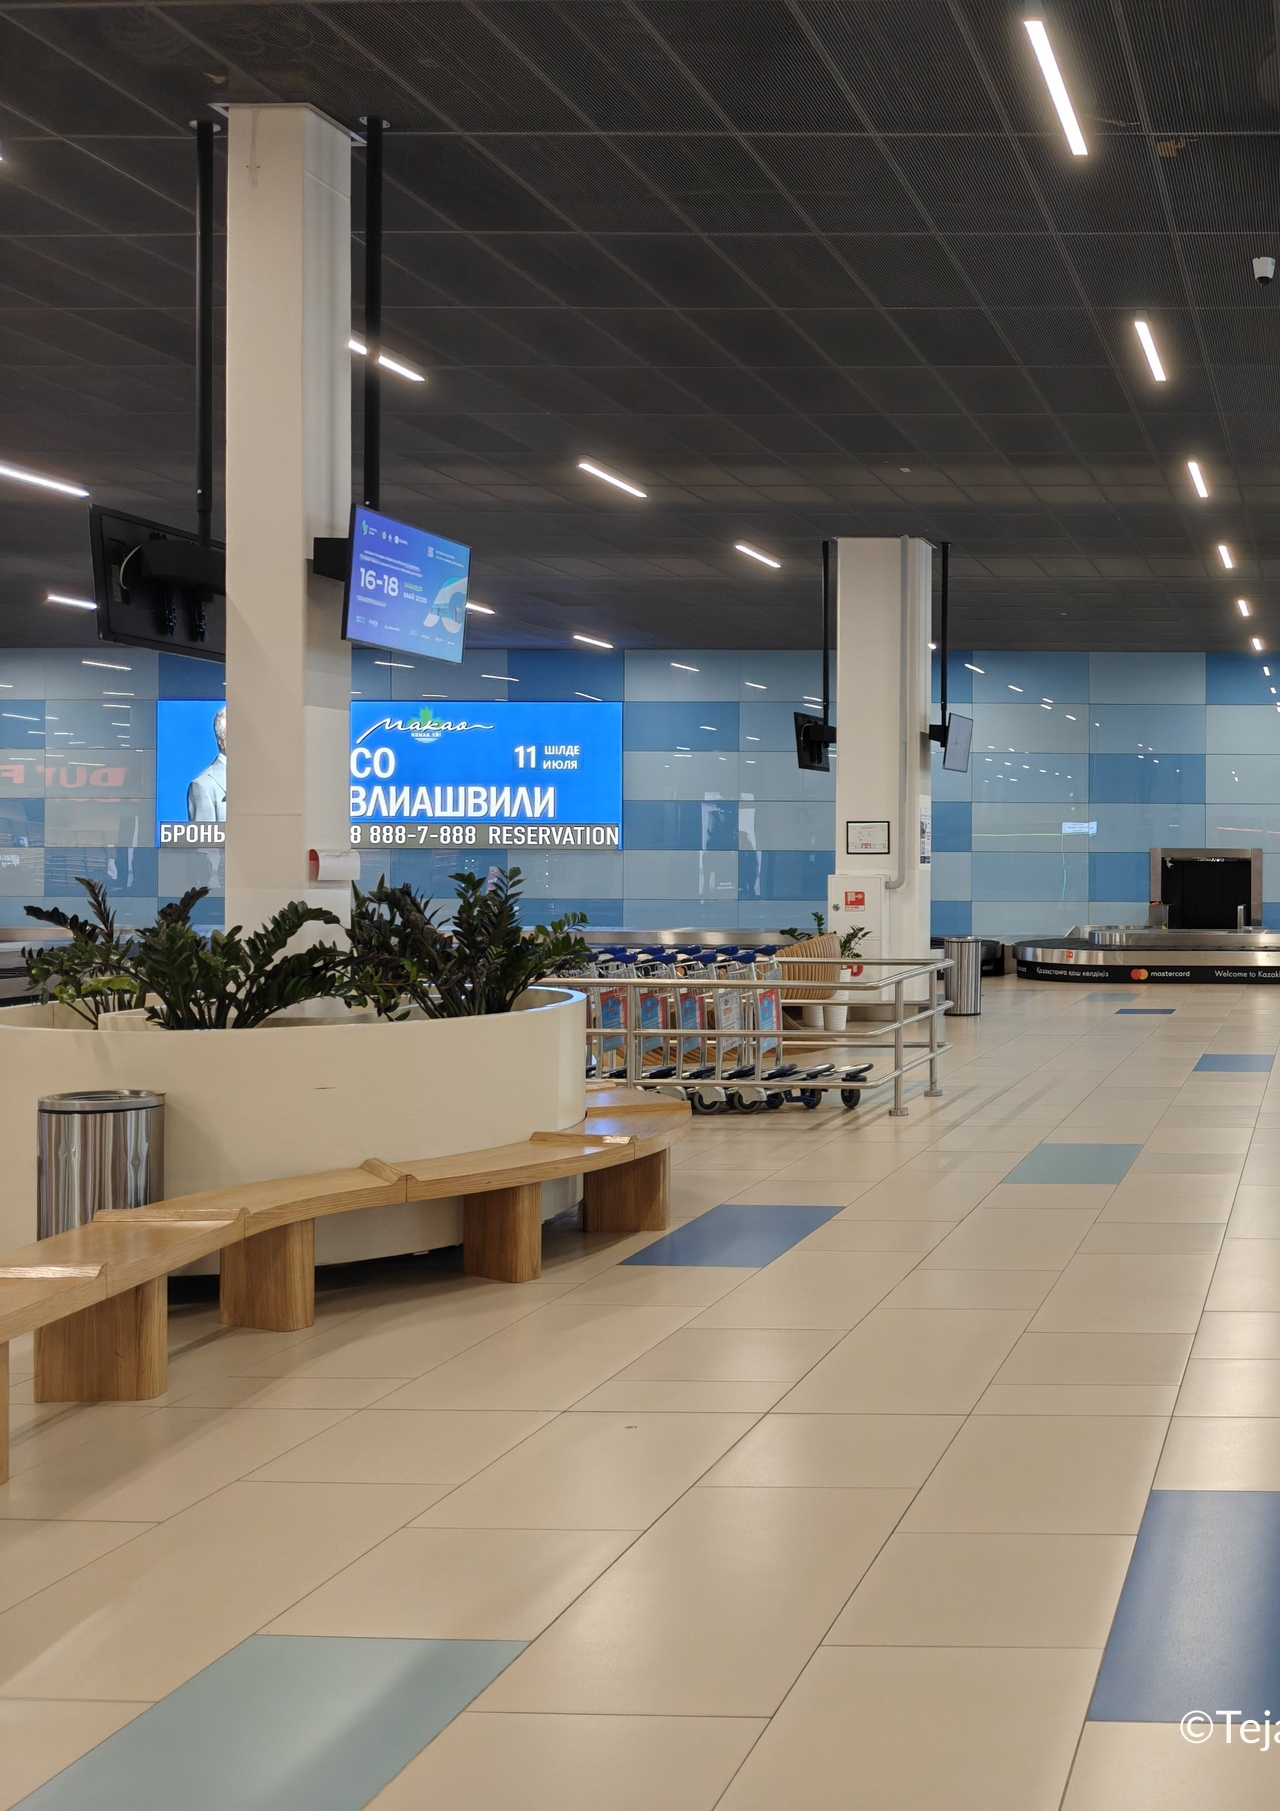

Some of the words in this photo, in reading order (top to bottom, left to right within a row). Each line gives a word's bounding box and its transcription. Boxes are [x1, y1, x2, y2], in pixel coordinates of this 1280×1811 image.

[359, 567, 399, 597] 16-18
[514, 745, 536, 769] 11
[544, 745, 580, 757] ШІЛДЕ
[543, 760, 578, 770] ИЮЛЯ
[350, 786, 555, 818] ВЛИАШВИЛИ
[160, 824, 226, 843] БРОНЬ
[369, 825, 477, 844] 888-7-888
[488, 826, 619, 845] RESERVATION
[1214, 970, 1248, 978] Welcome
